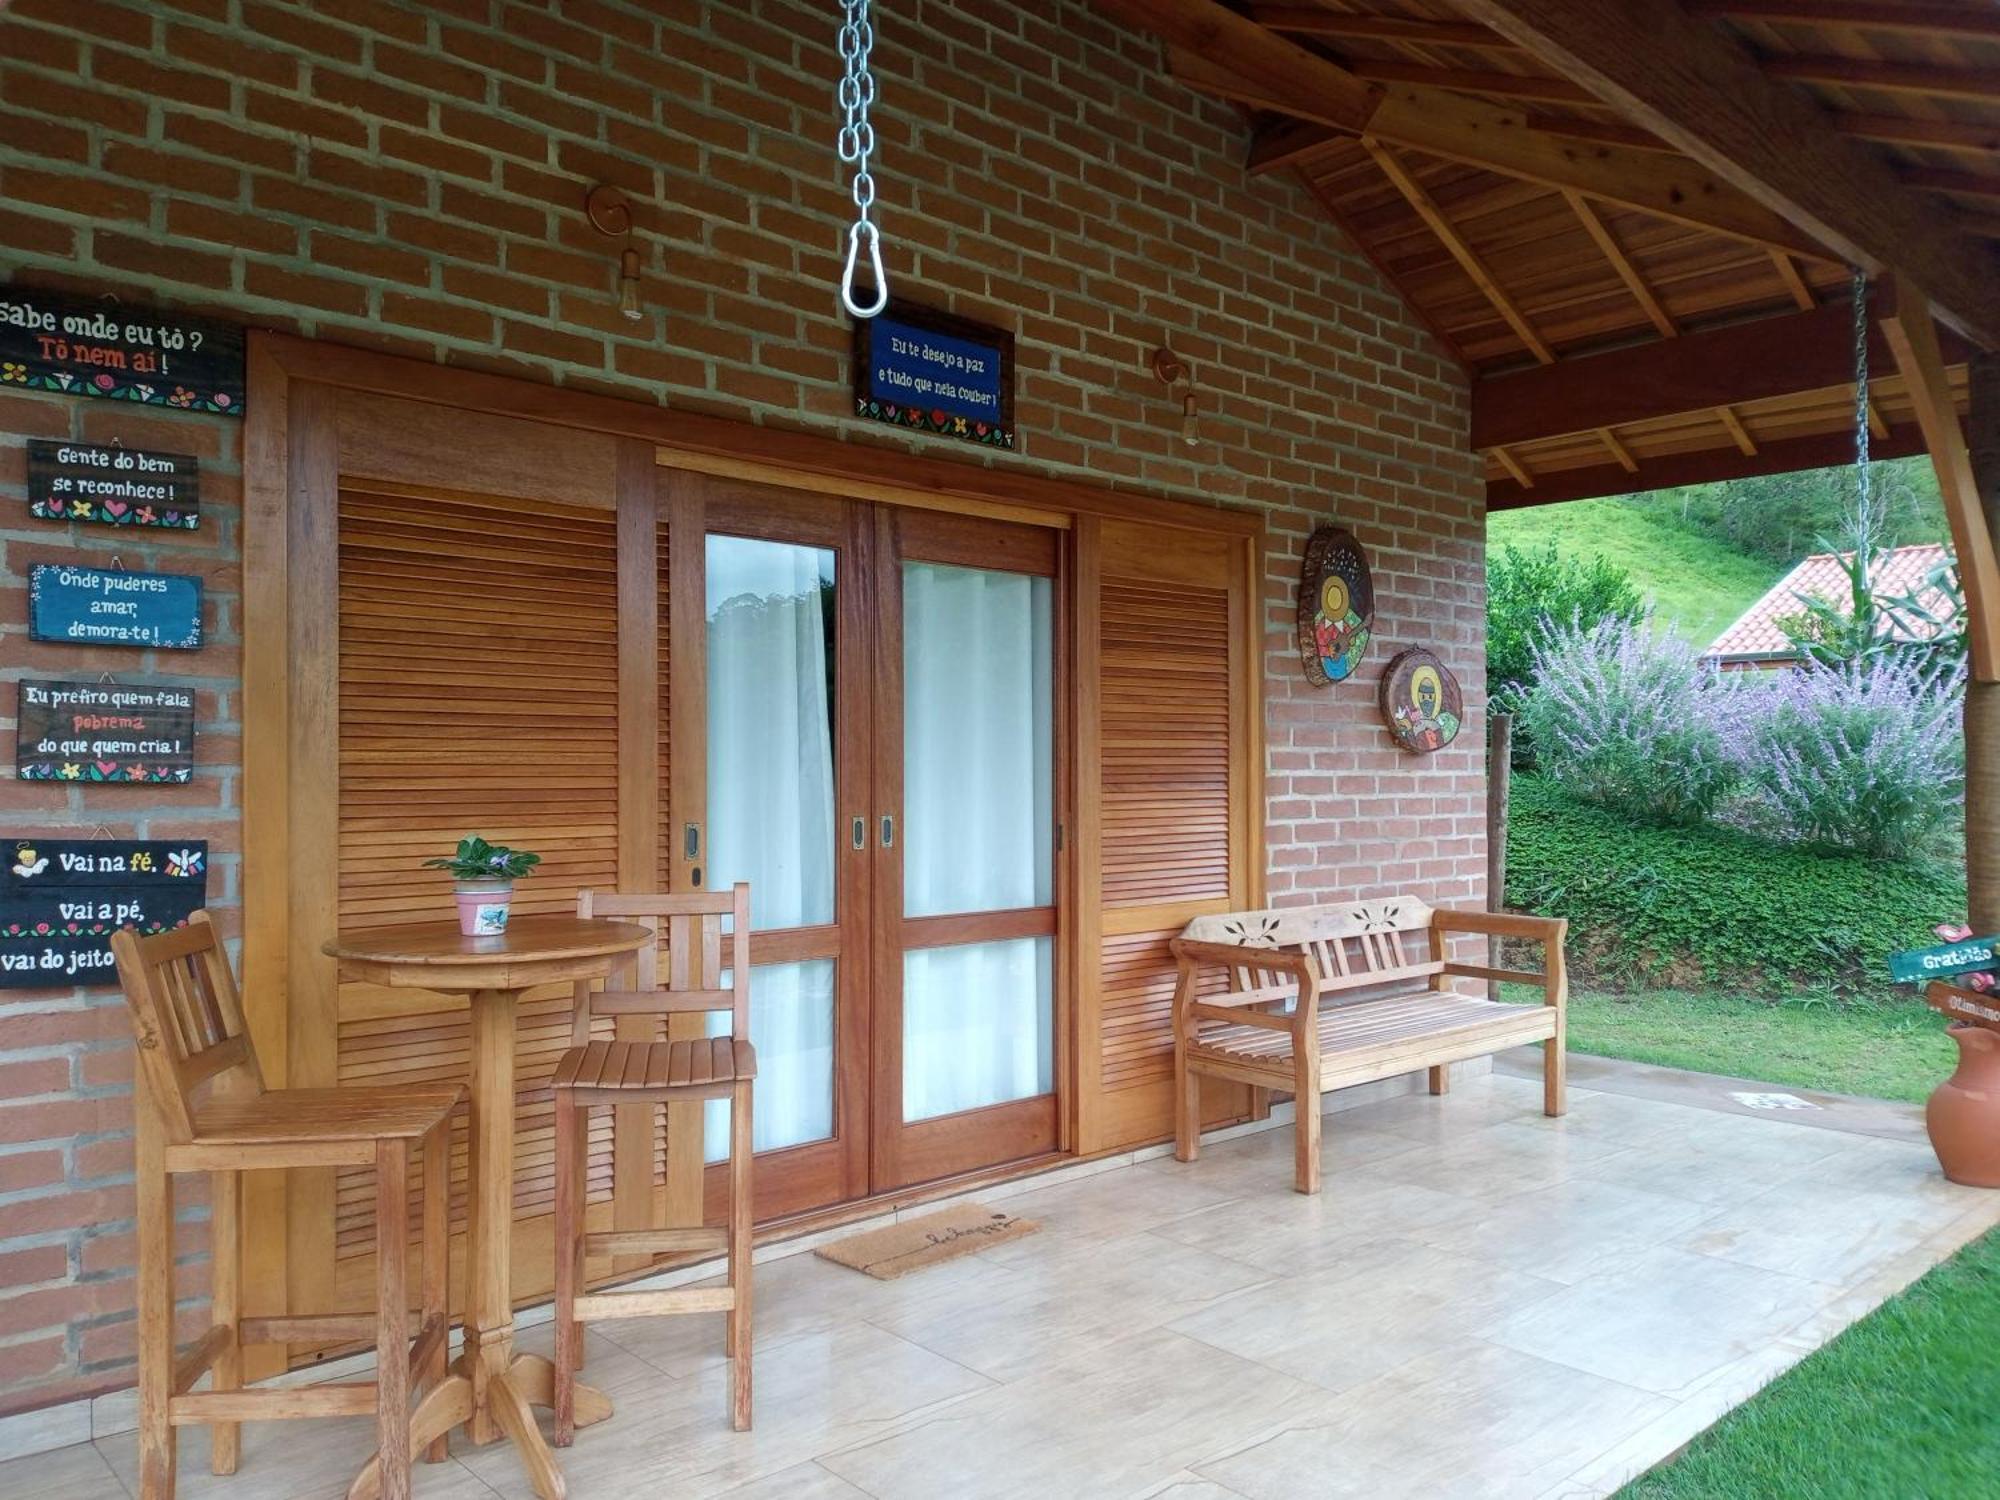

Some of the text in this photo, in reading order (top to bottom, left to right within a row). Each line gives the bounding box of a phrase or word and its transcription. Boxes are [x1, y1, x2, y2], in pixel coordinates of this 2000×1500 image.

[63, 313, 119, 340] onde
[124, 325, 154, 346] eu
[73, 345, 127, 369] nem
[891, 336, 985, 374] Eu te desejo a paz
[878, 368, 886, 382] e
[886, 368, 913, 388] tudo
[914, 378, 933, 394] que
[57, 448, 175, 473] Gente do bem
[53, 477, 72, 491] se
[59, 572, 167, 595] Onde puderes
[91, 601, 138, 618] amar,
[26, 686, 191, 709] Eu prefiro quem fala
[73, 714, 145, 733] pobrema
[37, 738, 57, 753] do
[60, 740, 88, 757] que
[92, 740, 136, 758] quem
[59, 853, 94, 872] Vai
[99, 855, 127, 872] na
[98, 903, 114, 919] a
[115, 900, 144, 925] pé,
[1, 948, 115, 975] vai do jeito
